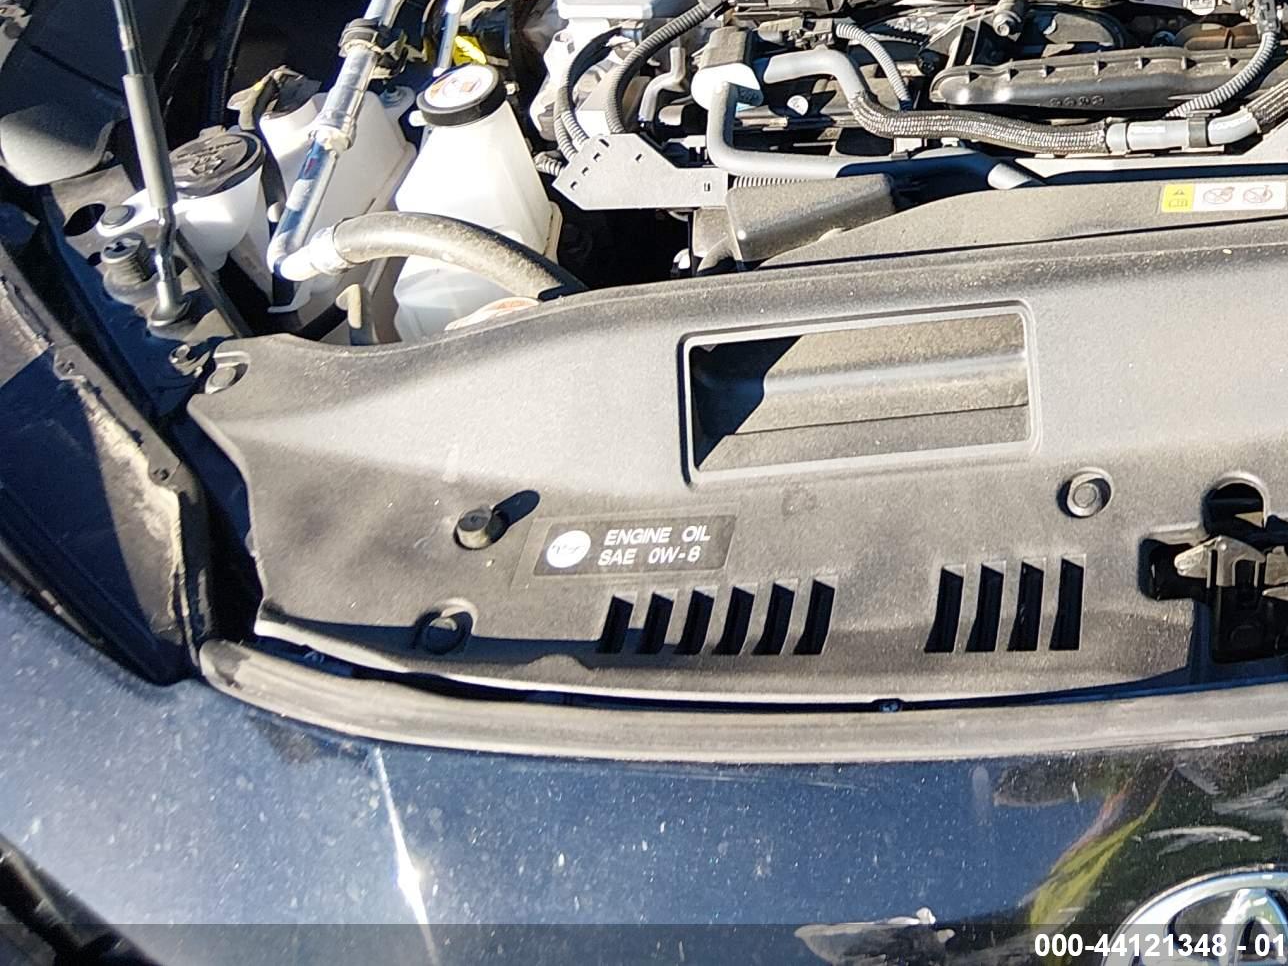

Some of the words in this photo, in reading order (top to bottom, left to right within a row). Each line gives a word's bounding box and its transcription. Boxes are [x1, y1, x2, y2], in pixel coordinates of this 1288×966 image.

[604, 527, 673, 546] ENGINE
[681, 525, 711, 543] OIL
[598, 548, 638, 566] SAE
[648, 545, 701, 564] 0W-8
